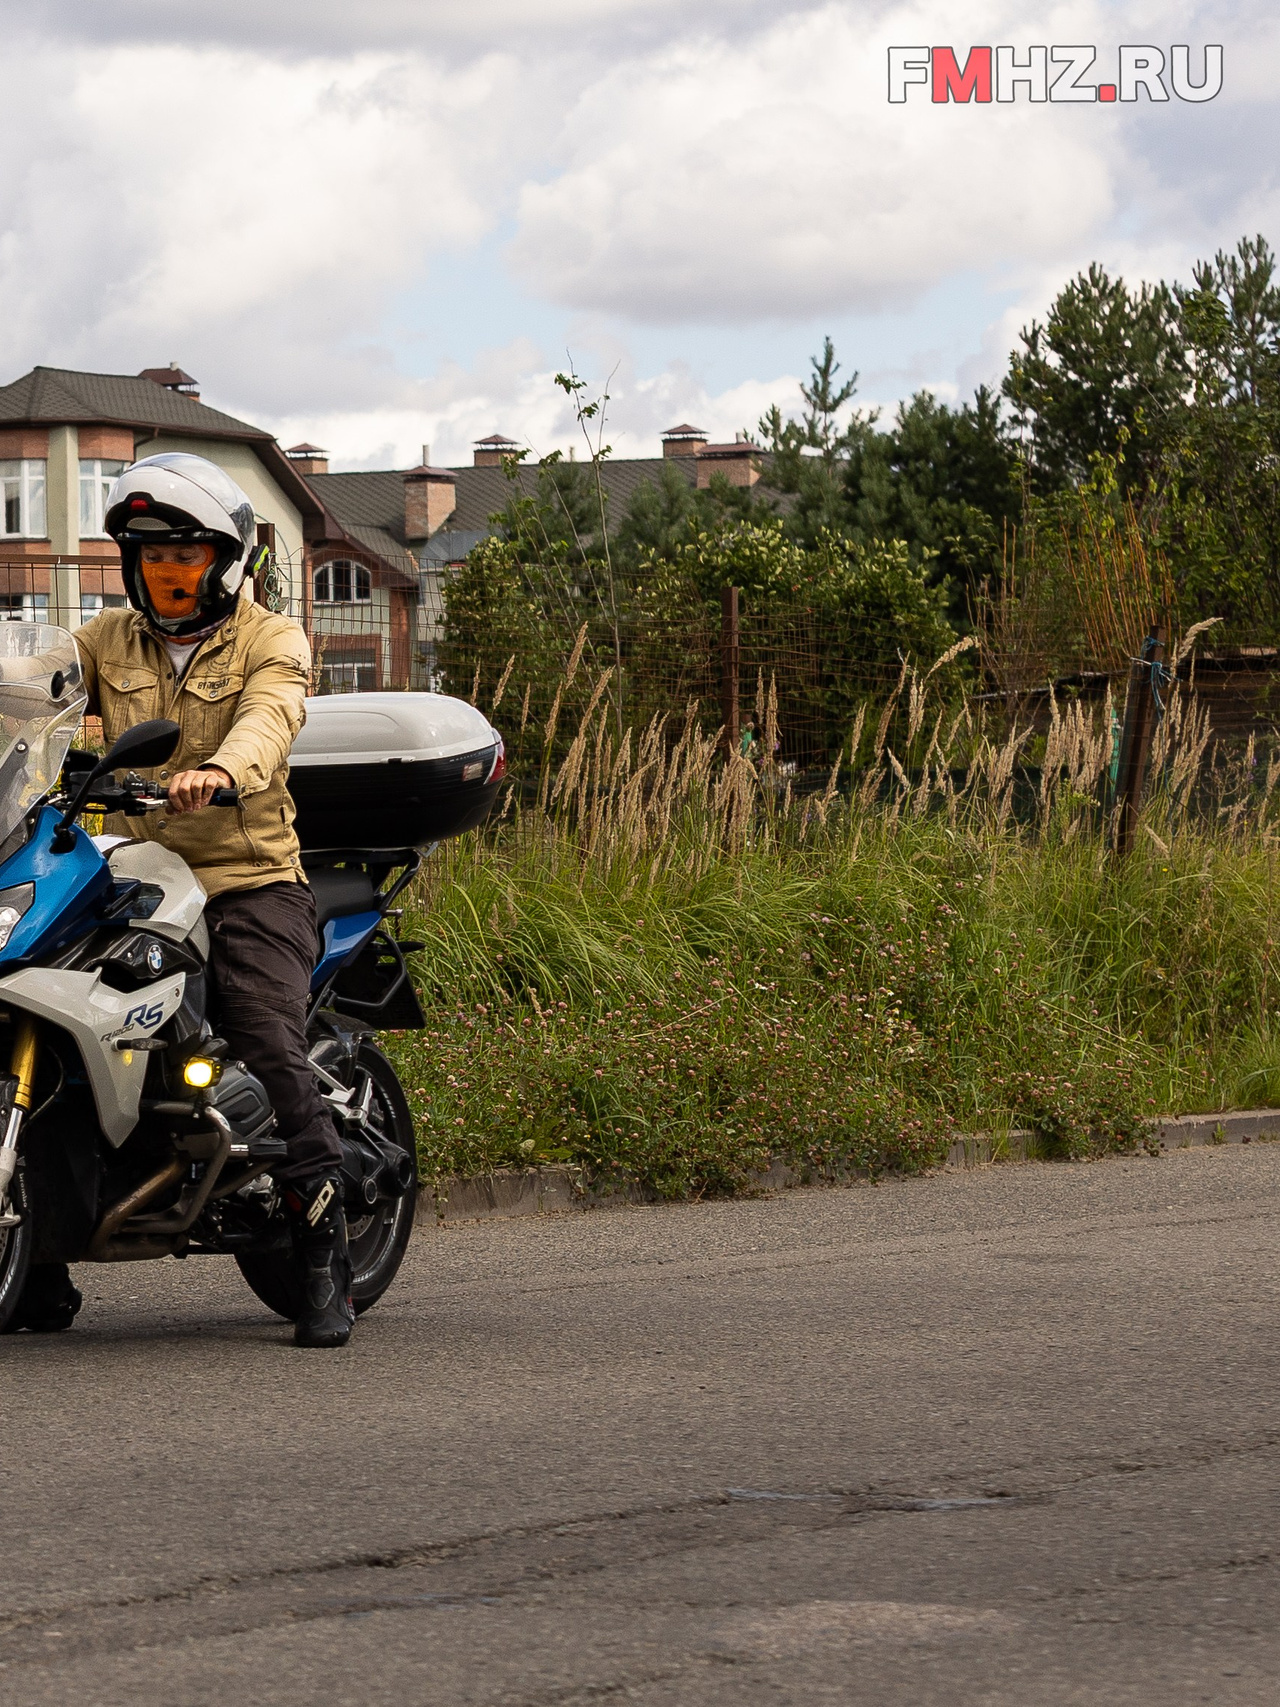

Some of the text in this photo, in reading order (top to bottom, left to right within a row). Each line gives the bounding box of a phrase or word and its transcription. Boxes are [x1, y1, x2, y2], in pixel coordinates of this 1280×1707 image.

[123, 1001, 164, 1029] RS
[18, 1172, 28, 1208] brembo
[306, 1180, 335, 1227] SIDI
